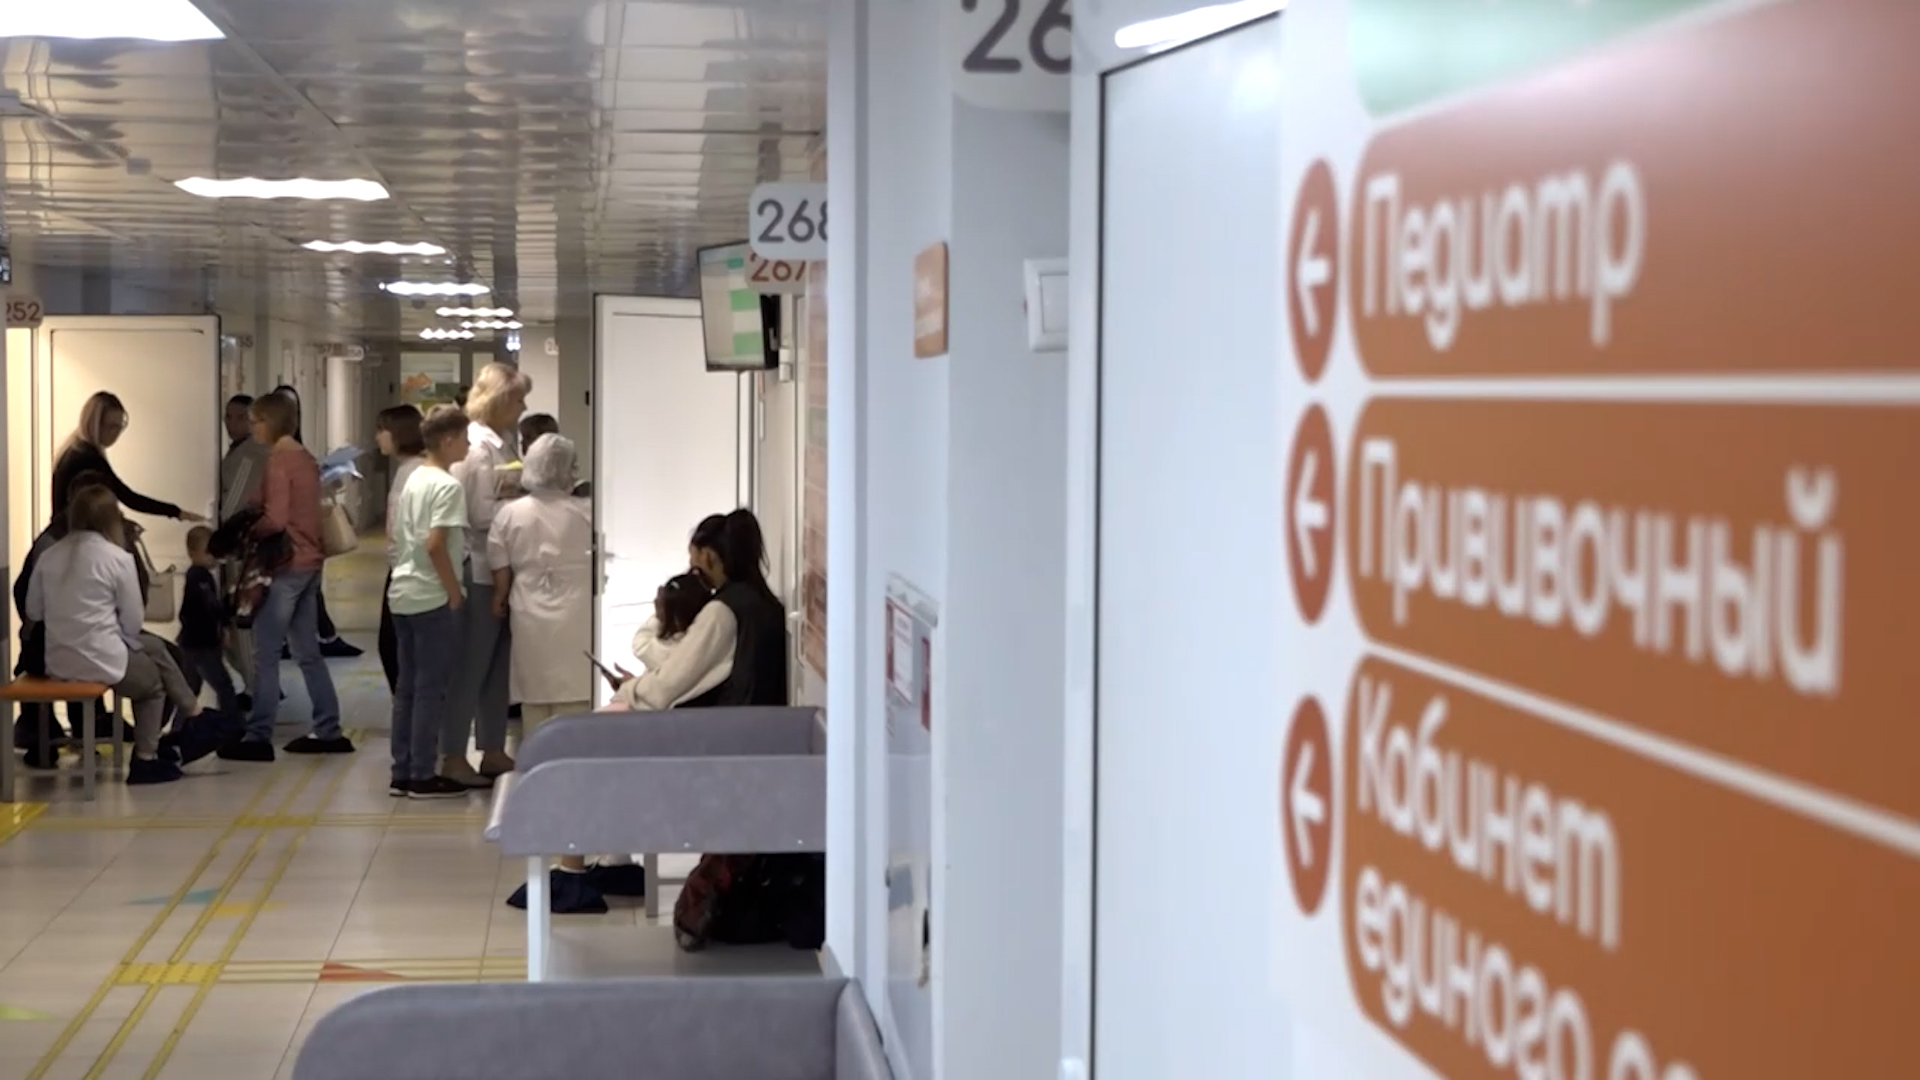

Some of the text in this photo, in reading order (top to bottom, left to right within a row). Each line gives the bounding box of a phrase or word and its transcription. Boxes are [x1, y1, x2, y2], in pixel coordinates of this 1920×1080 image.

[1362, 158, 1646, 349] Педиатр
[1359, 438, 1843, 694] Прививочный
[1358, 677, 1621, 950] Кабинет
